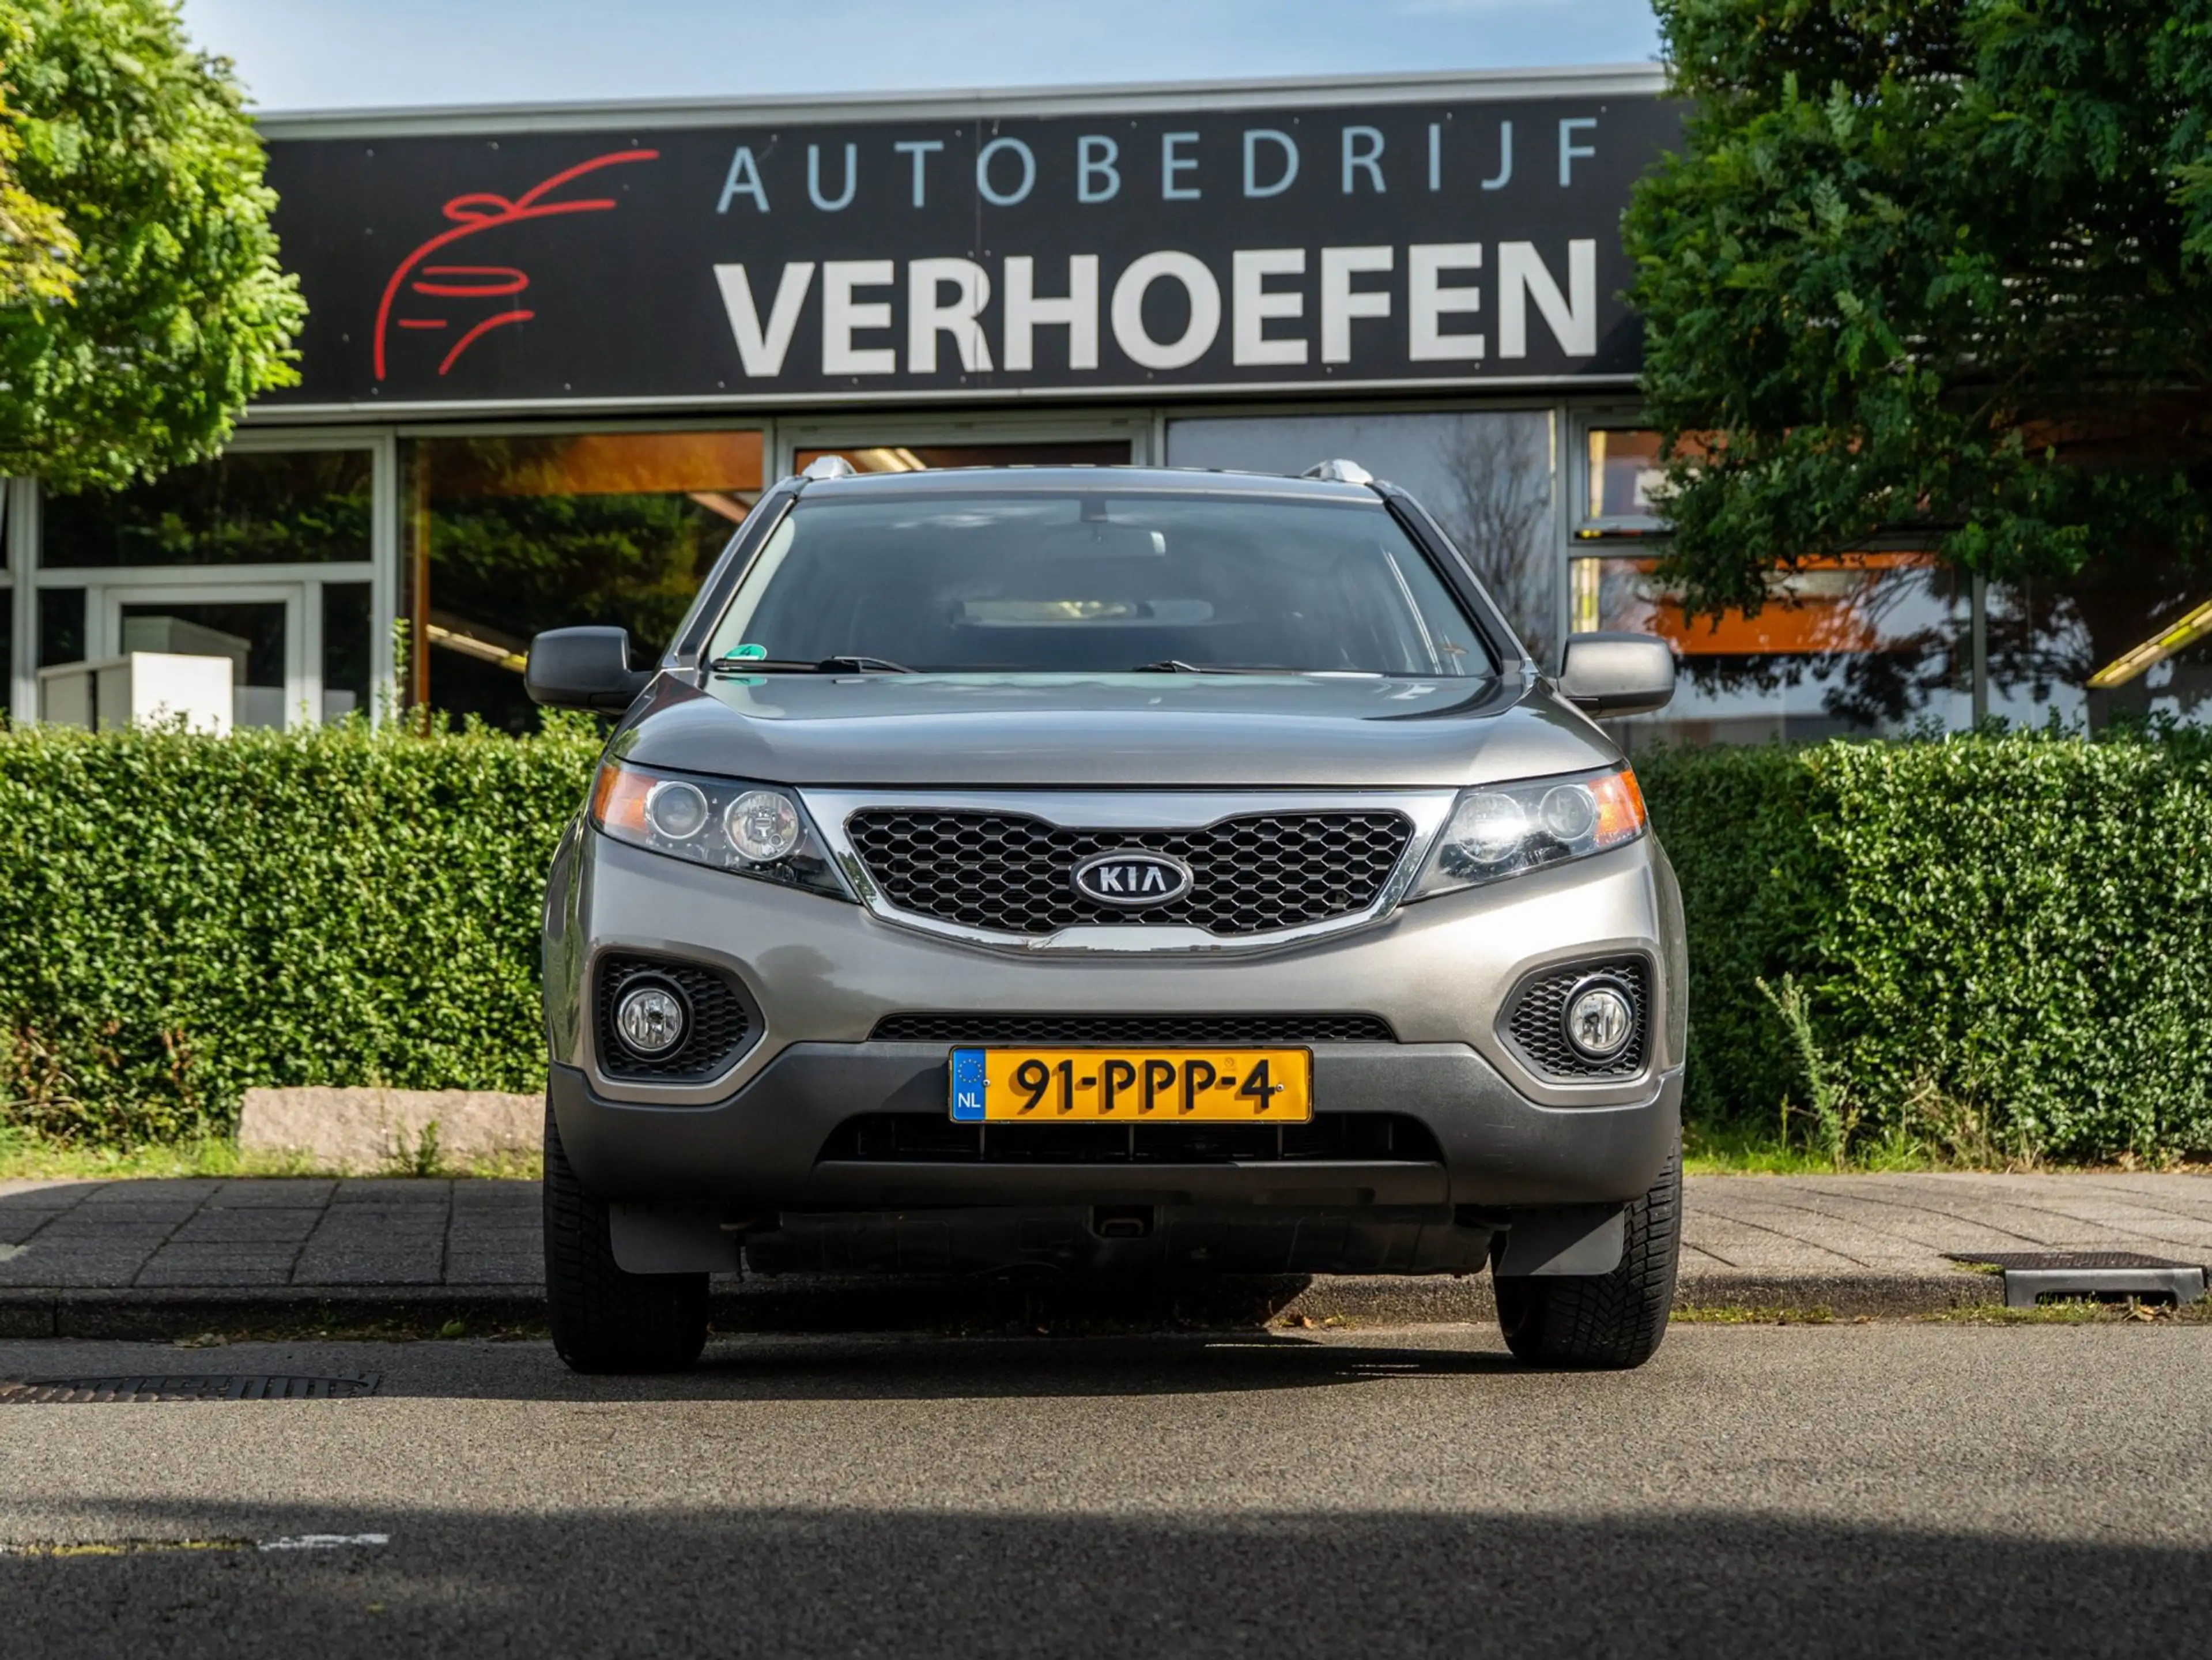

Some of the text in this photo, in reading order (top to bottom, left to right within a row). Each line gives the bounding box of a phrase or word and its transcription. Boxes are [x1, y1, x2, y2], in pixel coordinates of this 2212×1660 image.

[717, 118, 1597, 213] AUTOBEDRIJF
[714, 238, 1596, 376] VERHOEFEN
[1099, 866, 1167, 892] KIA
[958, 1092, 980, 1108] NL
[1017, 1059, 1275, 1110] 91-PPP-4
